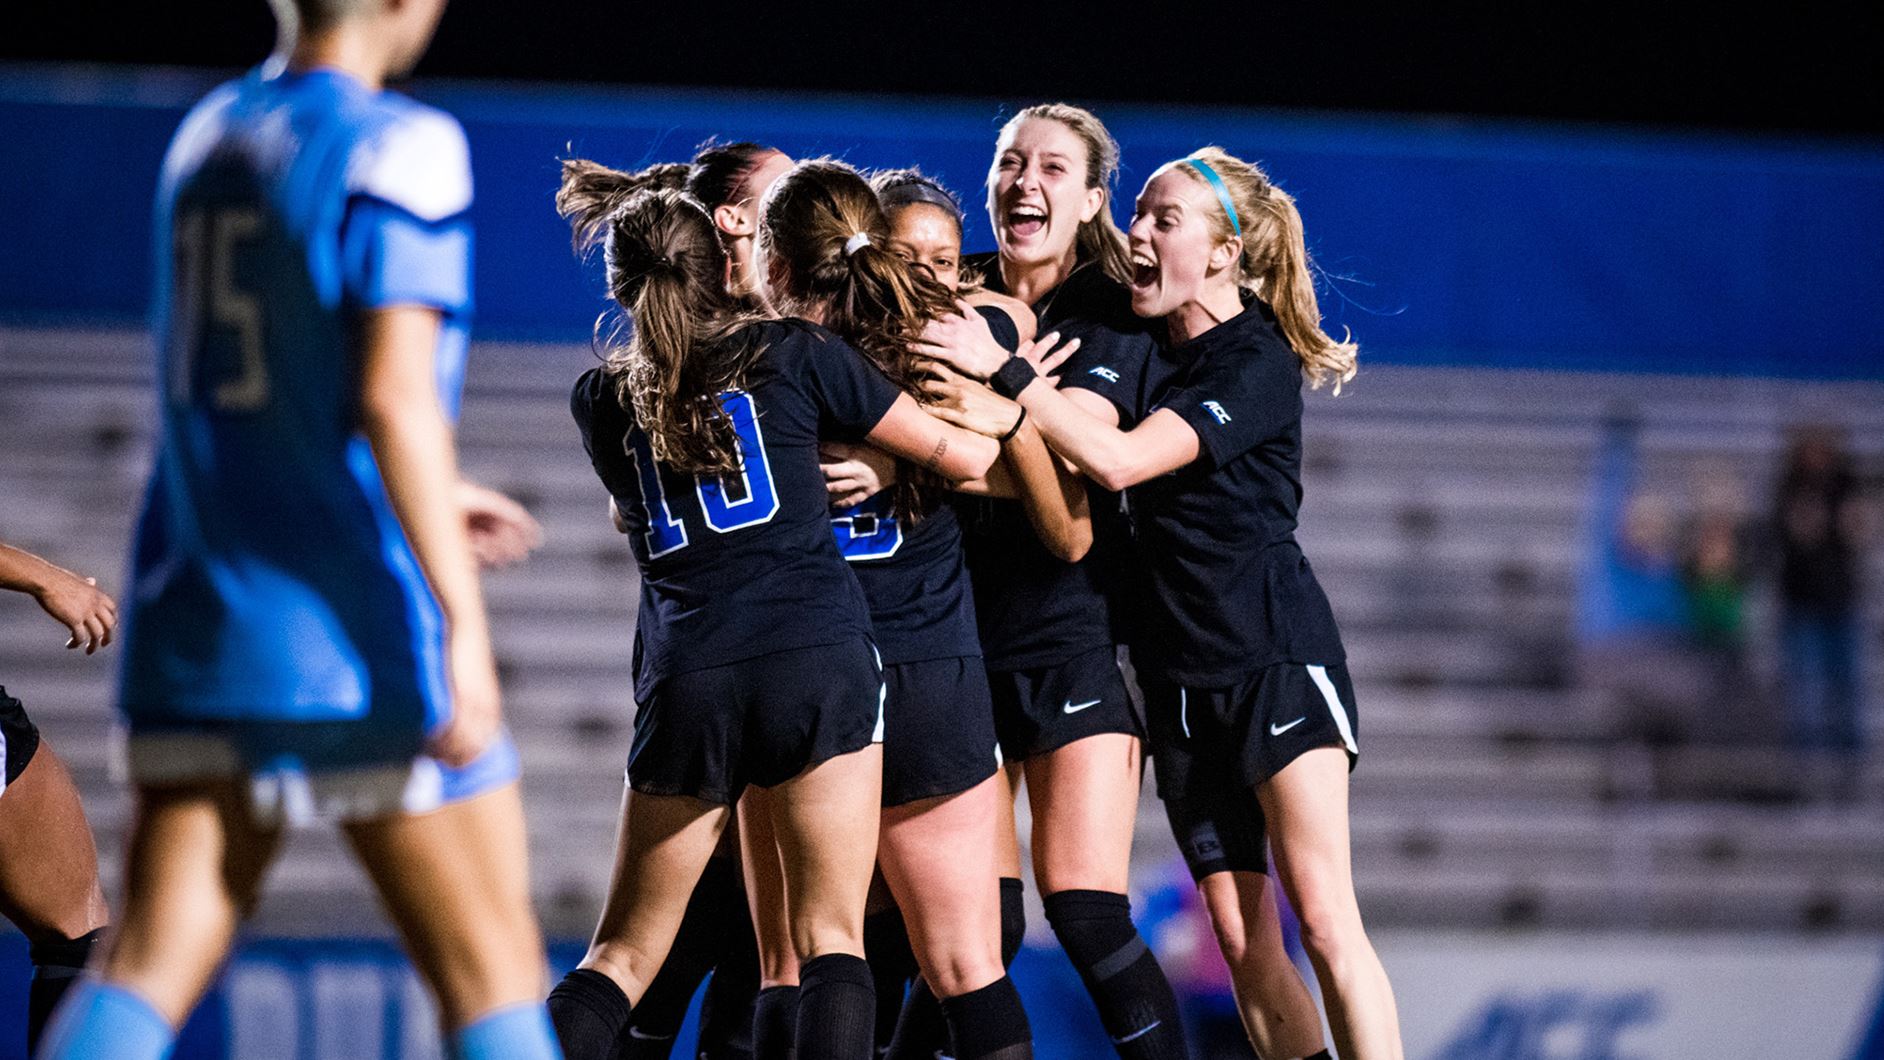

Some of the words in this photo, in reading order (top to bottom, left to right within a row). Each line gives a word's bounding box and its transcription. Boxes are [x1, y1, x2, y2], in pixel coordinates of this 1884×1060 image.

[170, 211, 265, 409] 15
[1088, 366, 1120, 383] ACC
[1201, 400, 1232, 425] ACC
[622, 387, 781, 560] 10
